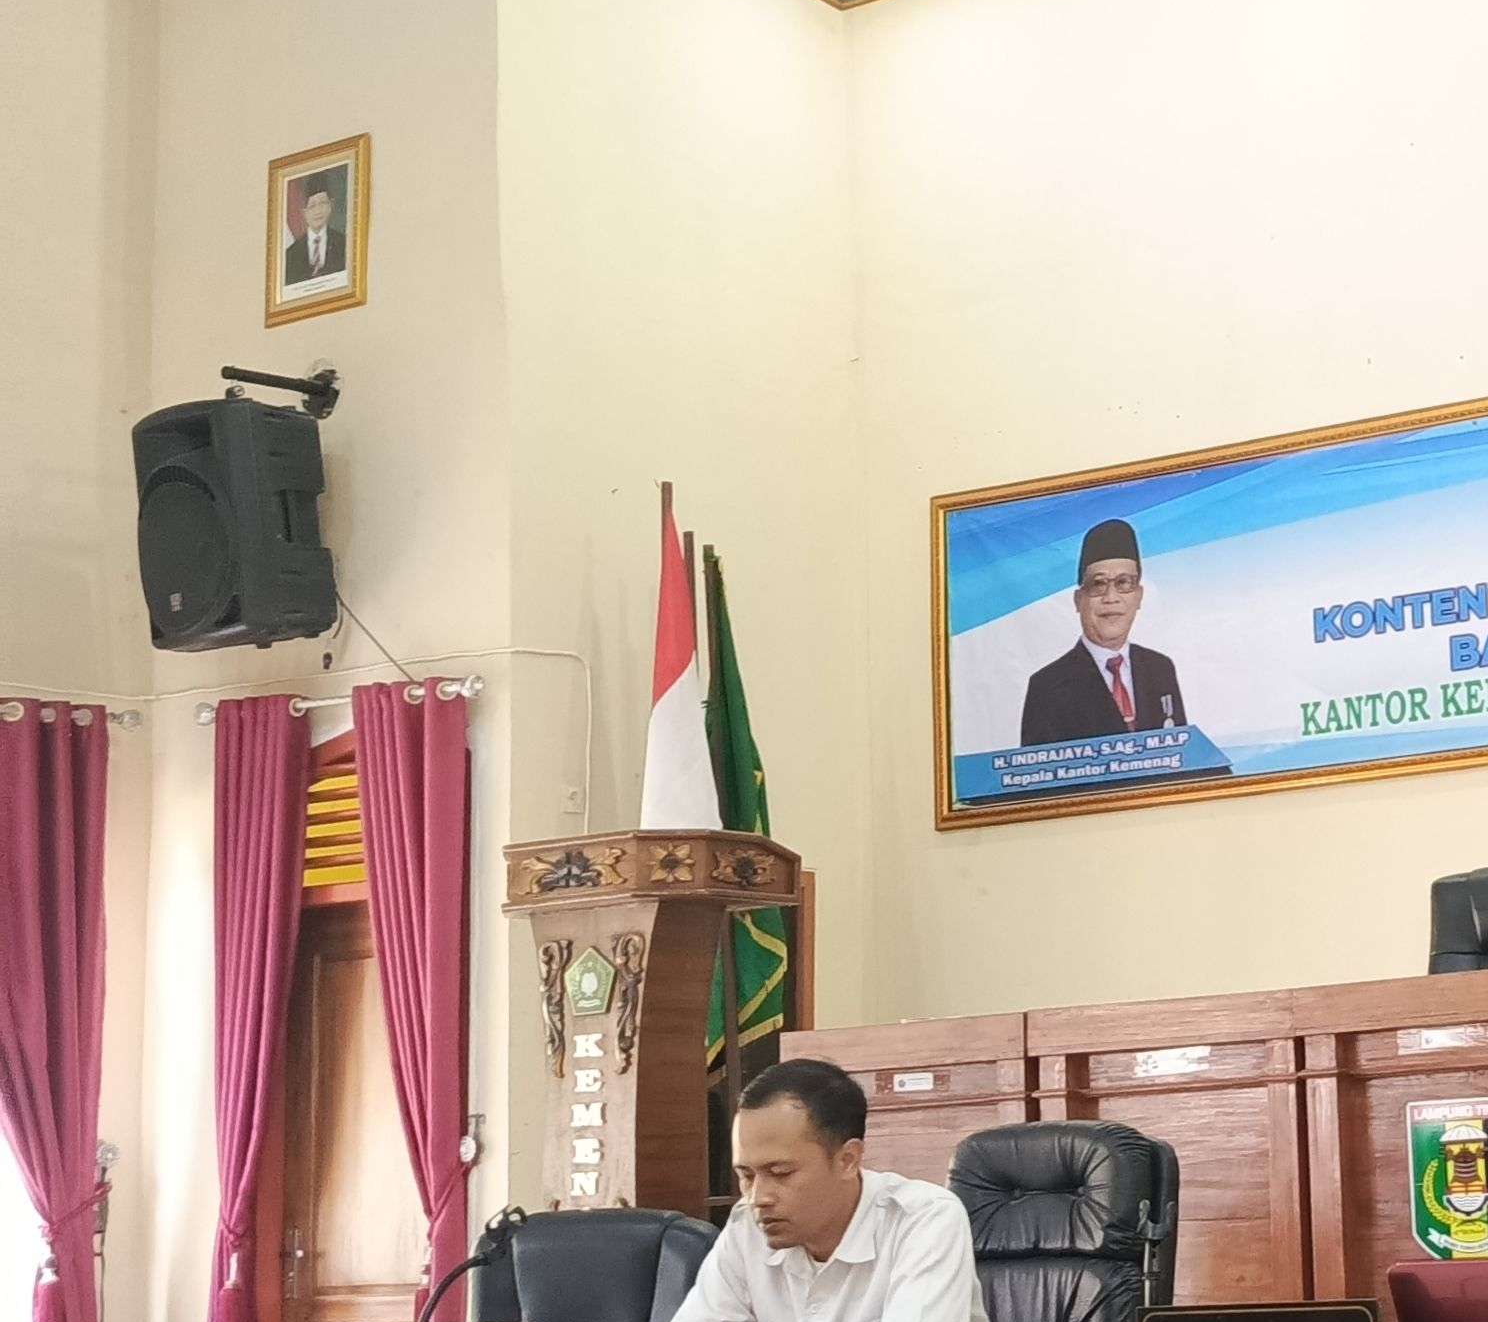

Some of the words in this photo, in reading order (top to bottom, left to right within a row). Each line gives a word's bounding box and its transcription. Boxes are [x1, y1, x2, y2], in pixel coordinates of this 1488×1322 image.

[1313, 583, 1488, 643] KONTEN
[1301, 687, 1431, 736] KANTOR
[993, 756, 1008, 770] H.
[1012, 746, 1098, 767] INDRAJAYA,
[1146, 733, 1189, 749] M.A.P
[1002, 770, 1054, 787] Kepala
[1057, 764, 1107, 780] Kantor
[1110, 753, 1181, 773] Kemenag
[1414, 1105, 1473, 1120] LAMPUNG
